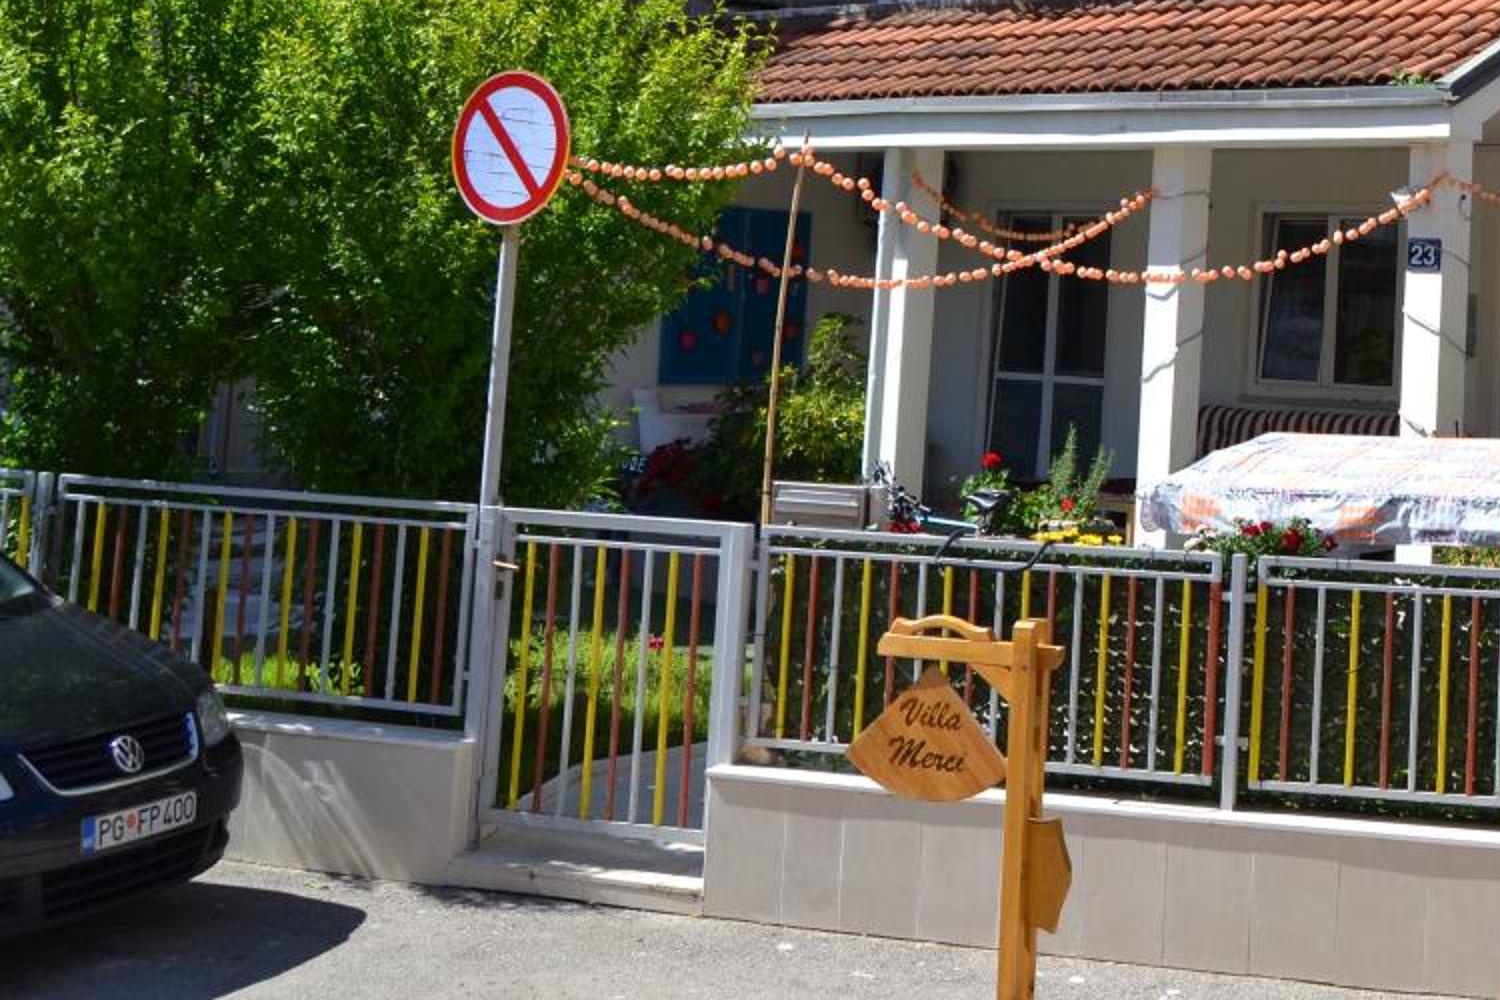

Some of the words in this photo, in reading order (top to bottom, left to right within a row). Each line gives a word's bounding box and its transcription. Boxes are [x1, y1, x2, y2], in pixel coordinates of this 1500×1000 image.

[1410, 244, 1436, 266] 23
[899, 697, 962, 731] Villa
[888, 735, 968, 772] Merci
[99, 815, 125, 847] PG
